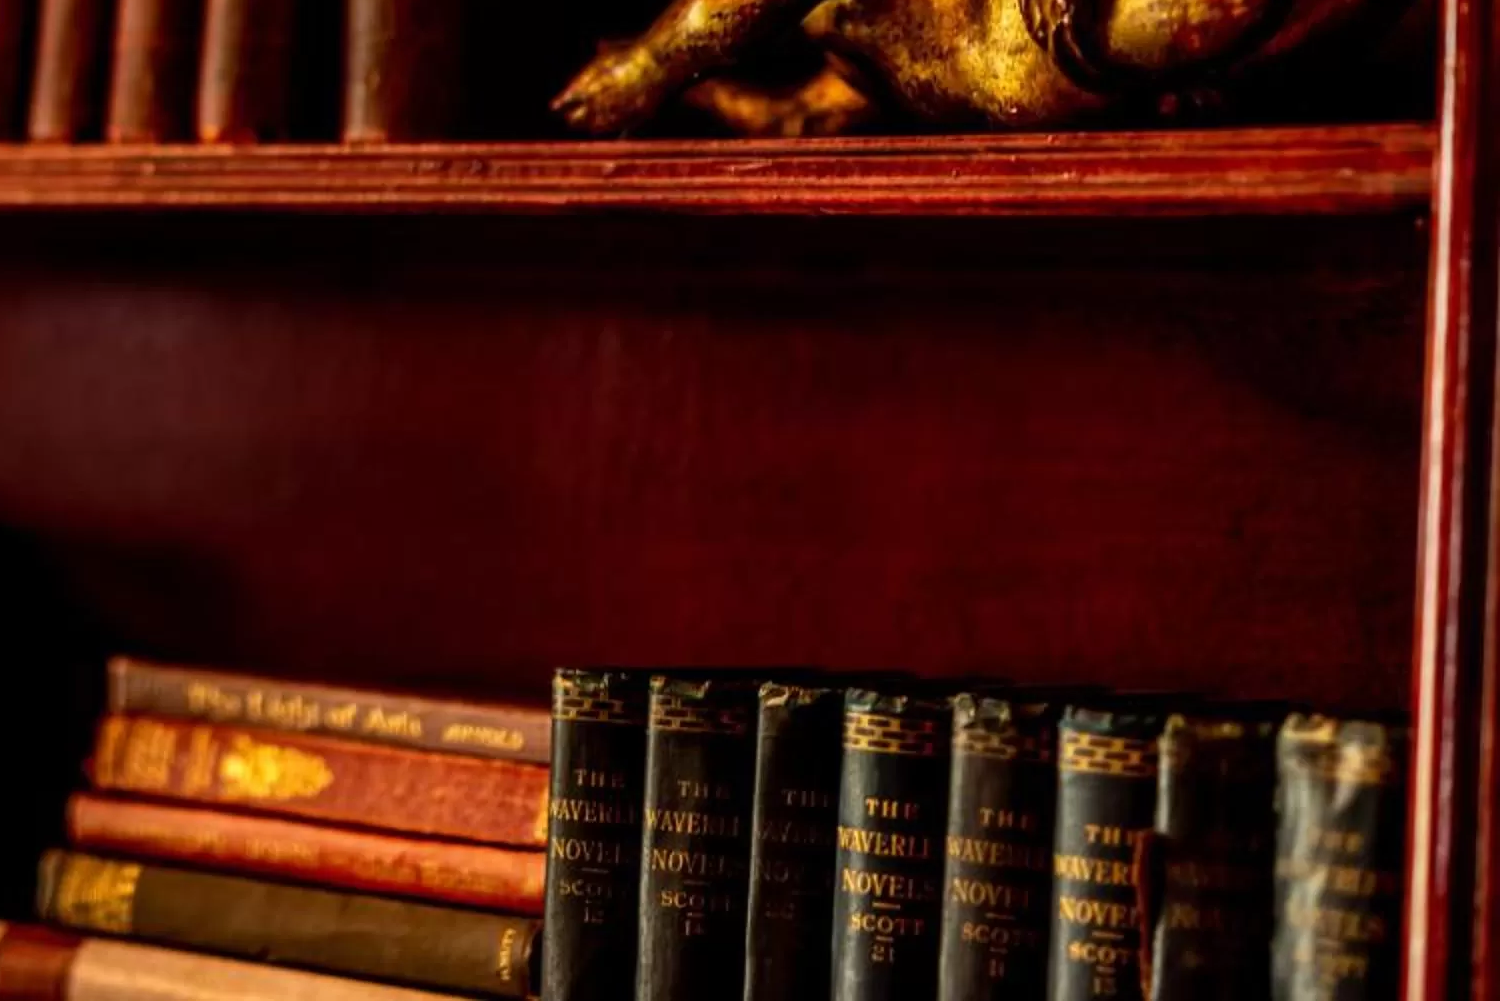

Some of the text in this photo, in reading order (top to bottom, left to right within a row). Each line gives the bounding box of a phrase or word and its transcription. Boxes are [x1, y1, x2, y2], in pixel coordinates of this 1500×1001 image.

[865, 797, 920, 820] THE
[849, 911, 925, 936] SCOTT
[1067, 941, 1131, 964] SCOT
